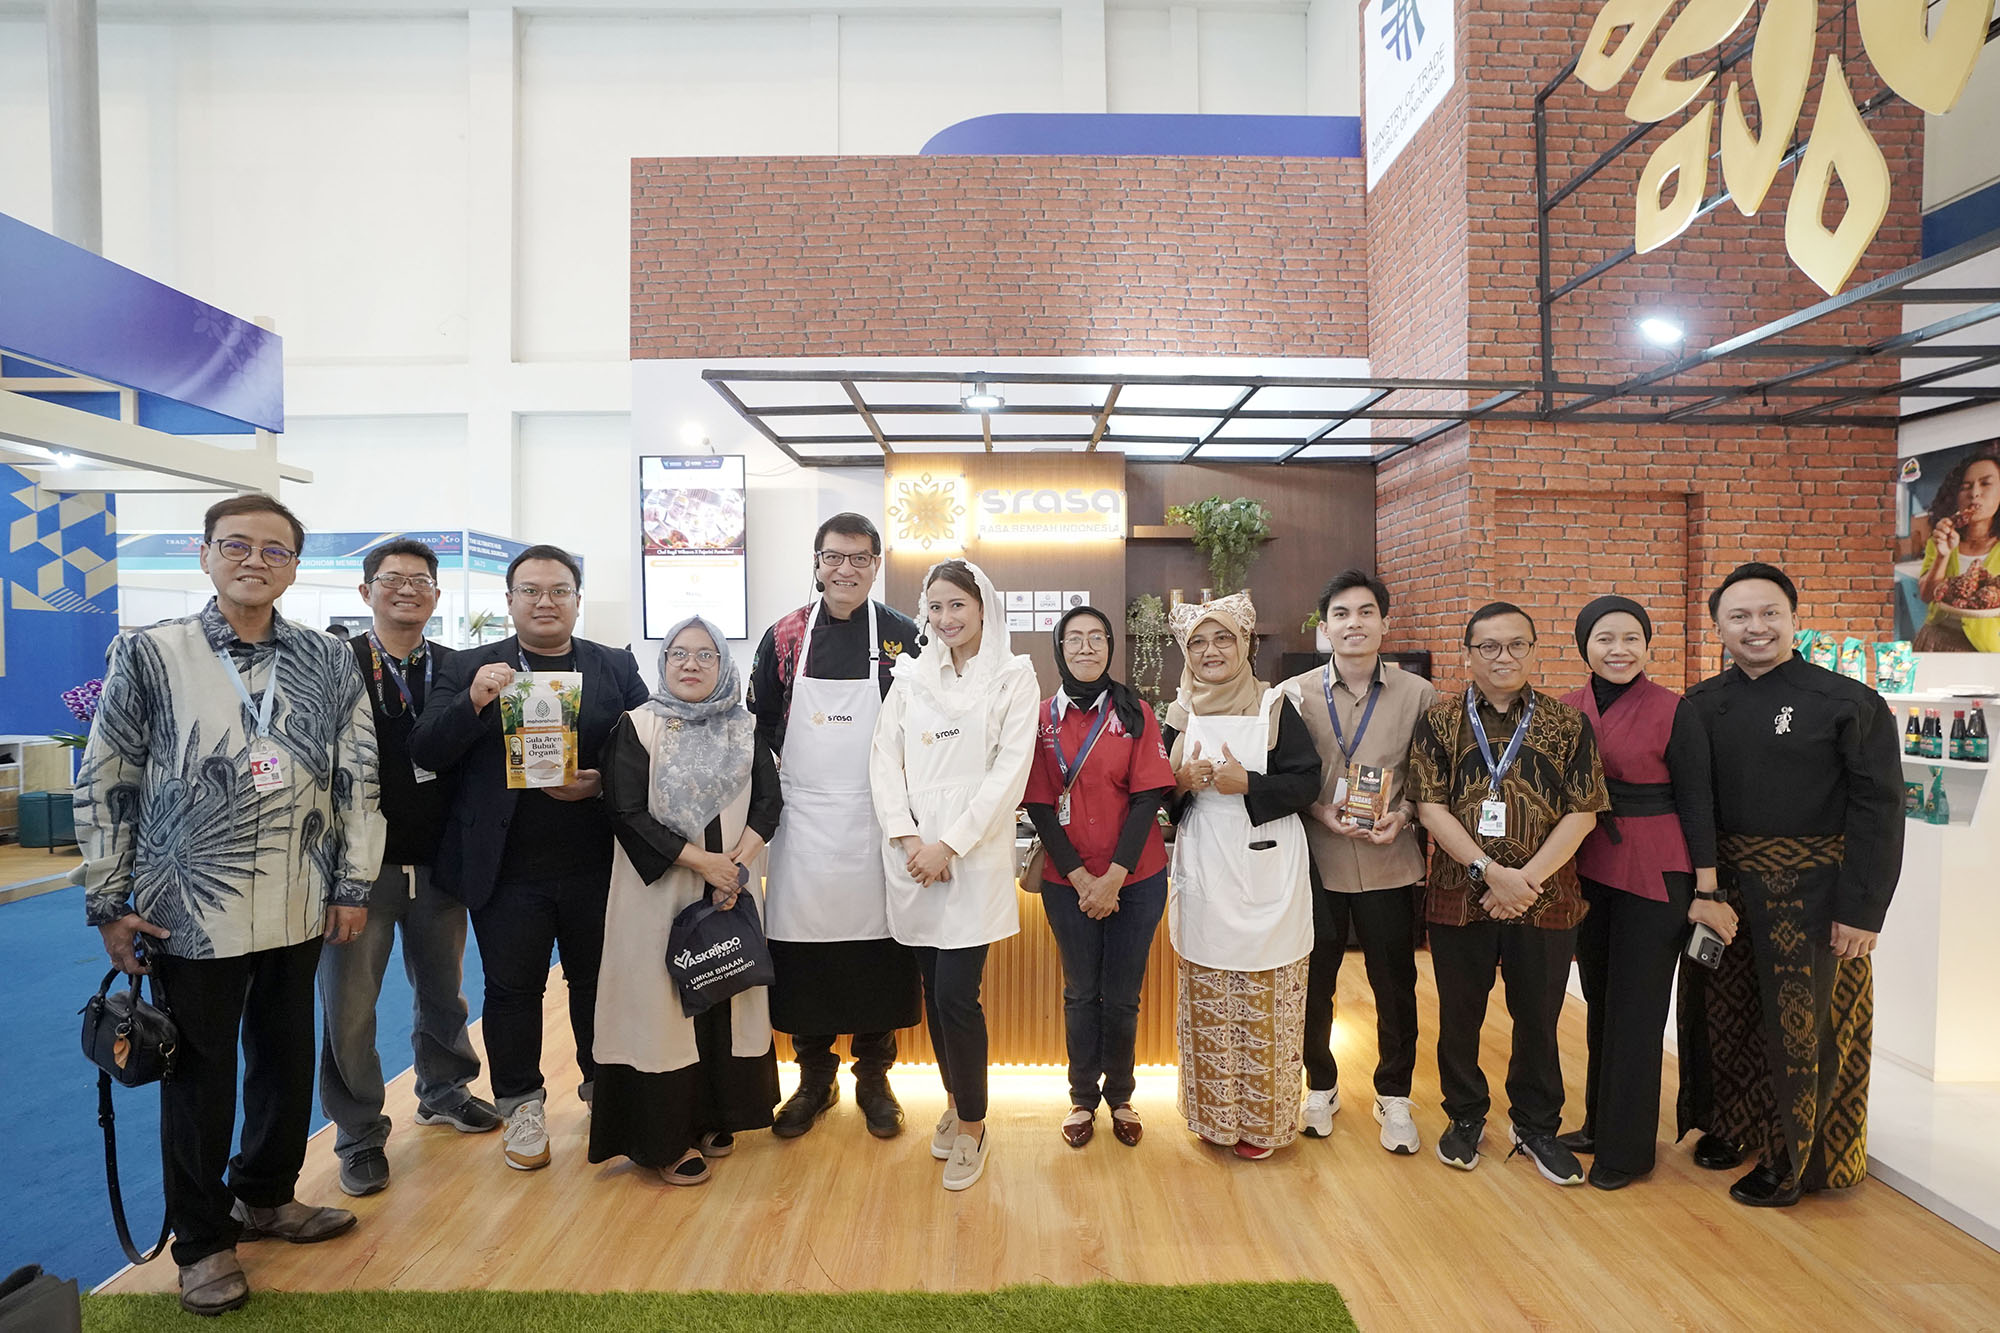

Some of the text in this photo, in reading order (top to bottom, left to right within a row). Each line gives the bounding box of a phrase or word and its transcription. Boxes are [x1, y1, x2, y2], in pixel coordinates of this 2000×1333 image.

[1371, 42, 1445, 152] MINISTRY OF TRADE
[1372, 125, 1399, 166] REPUBLIC
[1409, 64, 1445, 119] INDONESIA
[980, 524, 1119, 533] RASA REMPAH INDONESIA
[528, 749, 561, 758] Organik
[688, 936, 741, 967] ASKRINDO
[717, 944, 742, 959] PEDULI
[690, 957, 744, 985] UMKM BINAAN
[724, 960, 756, 979] (PERSERO)
